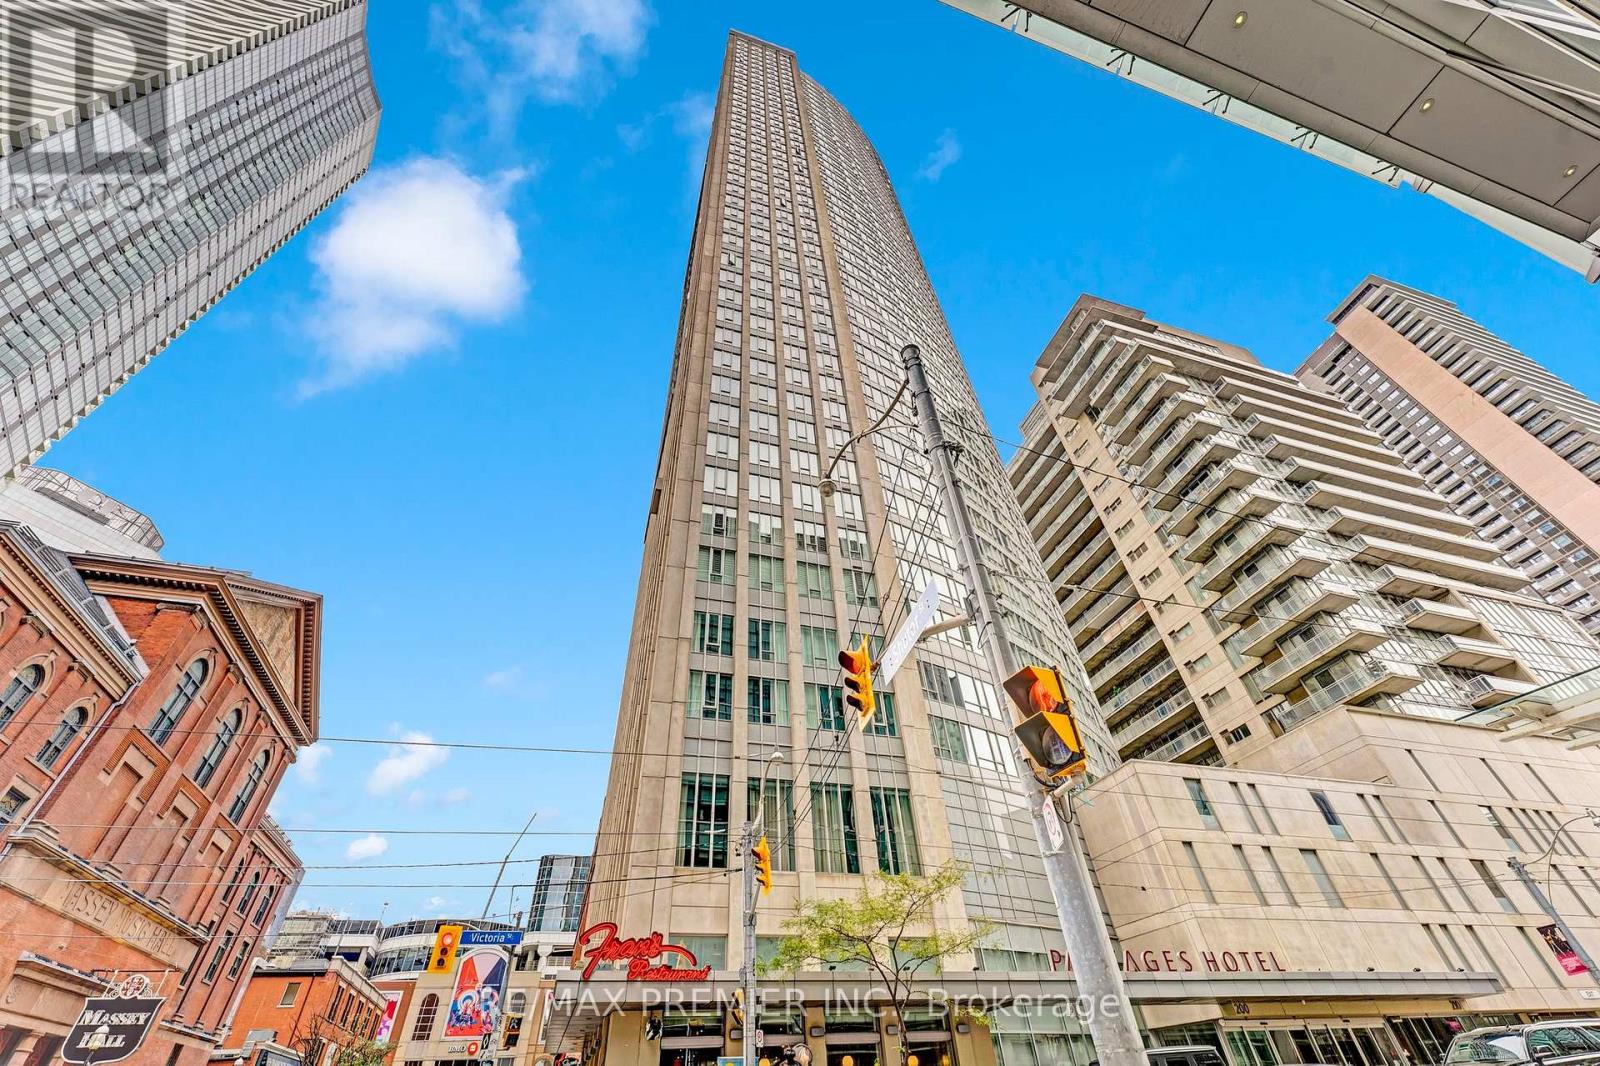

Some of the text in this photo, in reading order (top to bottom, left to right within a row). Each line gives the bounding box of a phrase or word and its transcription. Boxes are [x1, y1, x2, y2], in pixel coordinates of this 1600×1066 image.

[471, 932, 506, 943] Victoria
[627, 958, 712, 981] Restaurant
[1203, 950, 1286, 972] HOTEL
[77, 1009, 151, 1025] MASSEY
